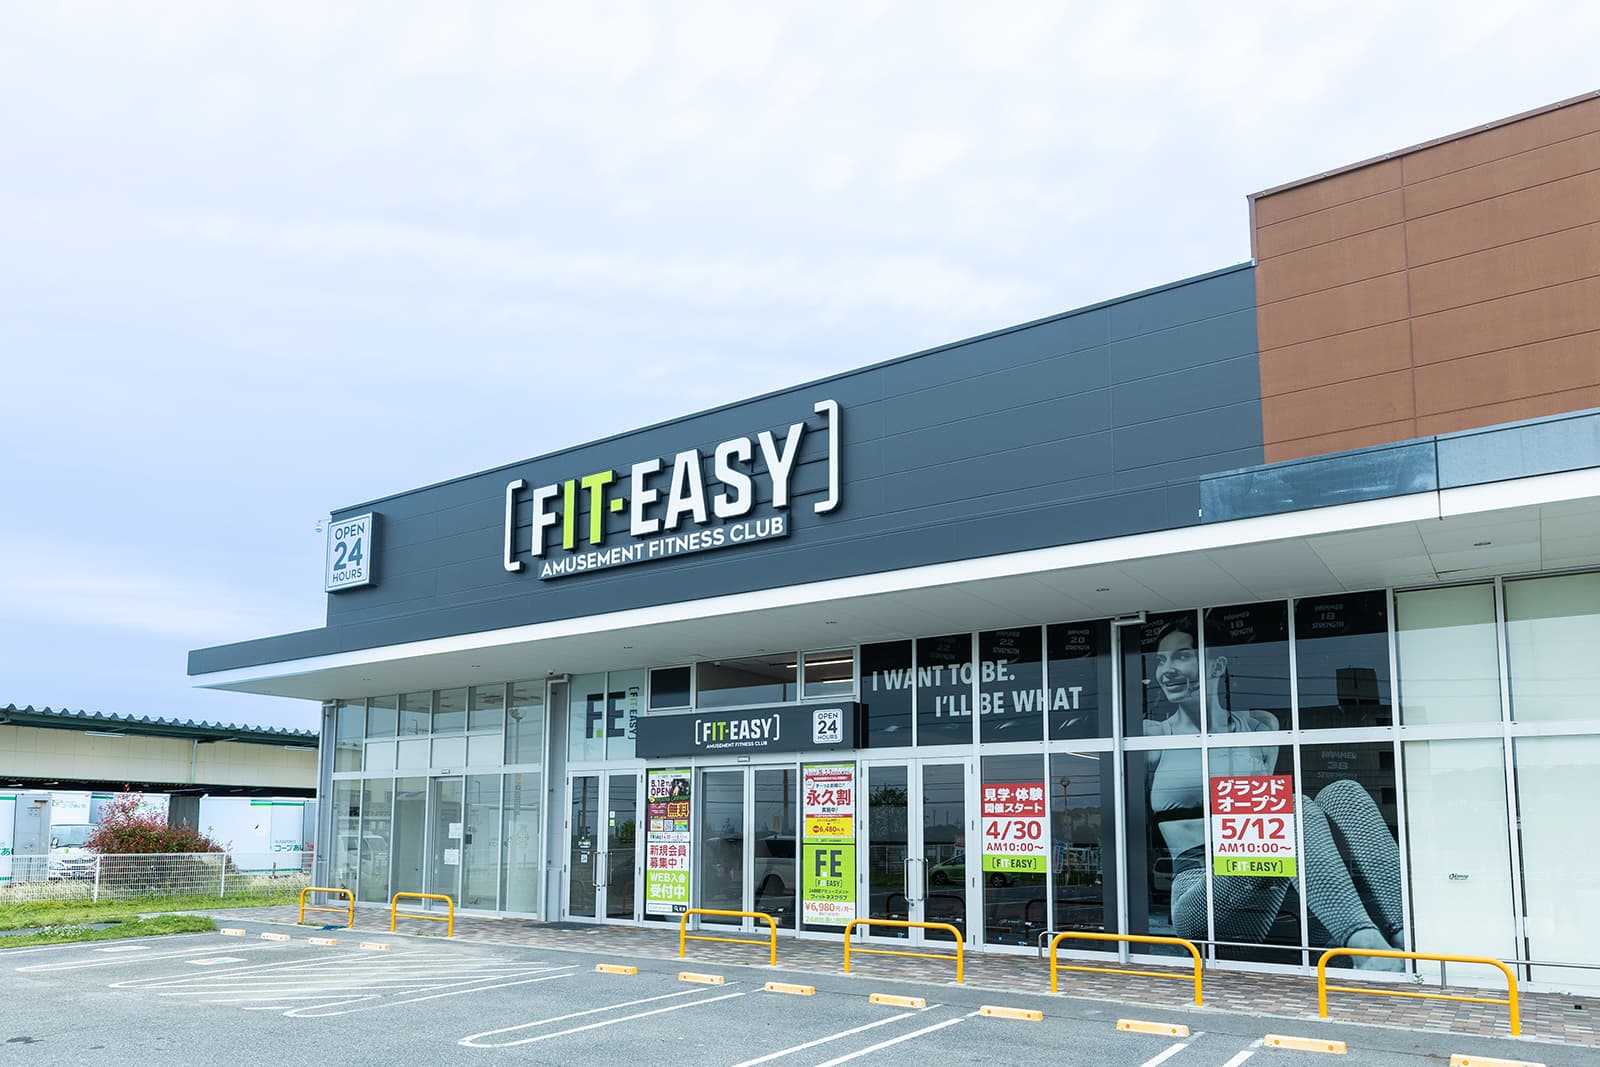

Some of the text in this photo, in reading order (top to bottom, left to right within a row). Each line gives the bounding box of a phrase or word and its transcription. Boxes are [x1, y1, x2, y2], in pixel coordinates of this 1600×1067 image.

[335, 522, 365, 540] OPEN
[333, 537, 363, 571] 24
[540, 516, 784, 577] AMUSEMENT FITNESS CLUB
[332, 568, 362, 582] HOURS
[872, 659, 1015, 691] I WANT TO BE.
[980, 691, 1005, 714] BE
[1012, 686, 1083, 713] WHAT
[817, 712, 839, 720] OPEN
[818, 720, 838, 734] 24
[1217, 779, 1285, 796] グランド
[806, 788, 851, 806] 永久割
[1217, 795, 1287, 812] オープン
[984, 802, 1043, 814] 開催スタート
[986, 820, 1042, 840] 4/30
[1221, 818, 1286, 840] 5/12
[649, 845, 687, 857] 新規会員
[649, 884, 686, 900] 受付中
